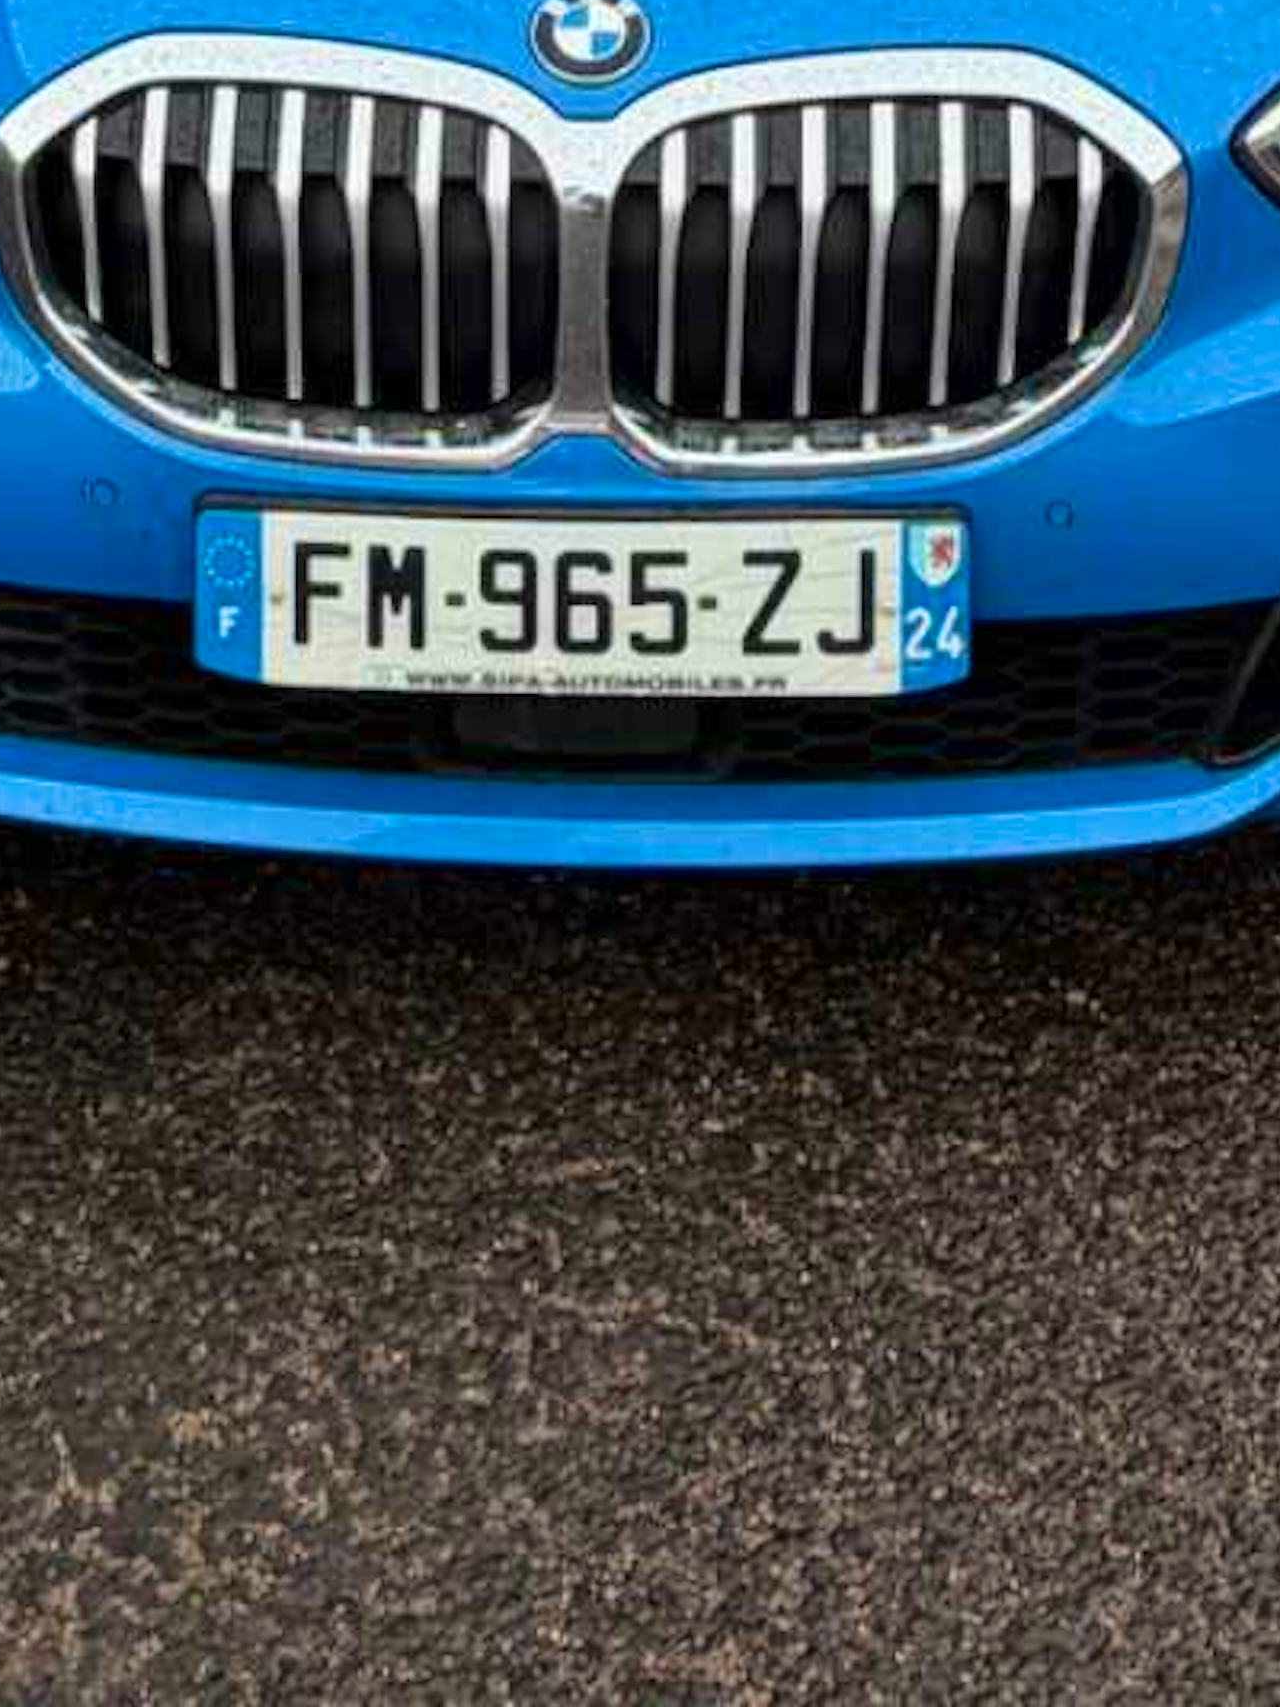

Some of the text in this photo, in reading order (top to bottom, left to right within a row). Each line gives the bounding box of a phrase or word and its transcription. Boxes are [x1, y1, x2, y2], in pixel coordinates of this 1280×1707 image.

[218, 541, 968, 661] F FM-965-ZJ 24
